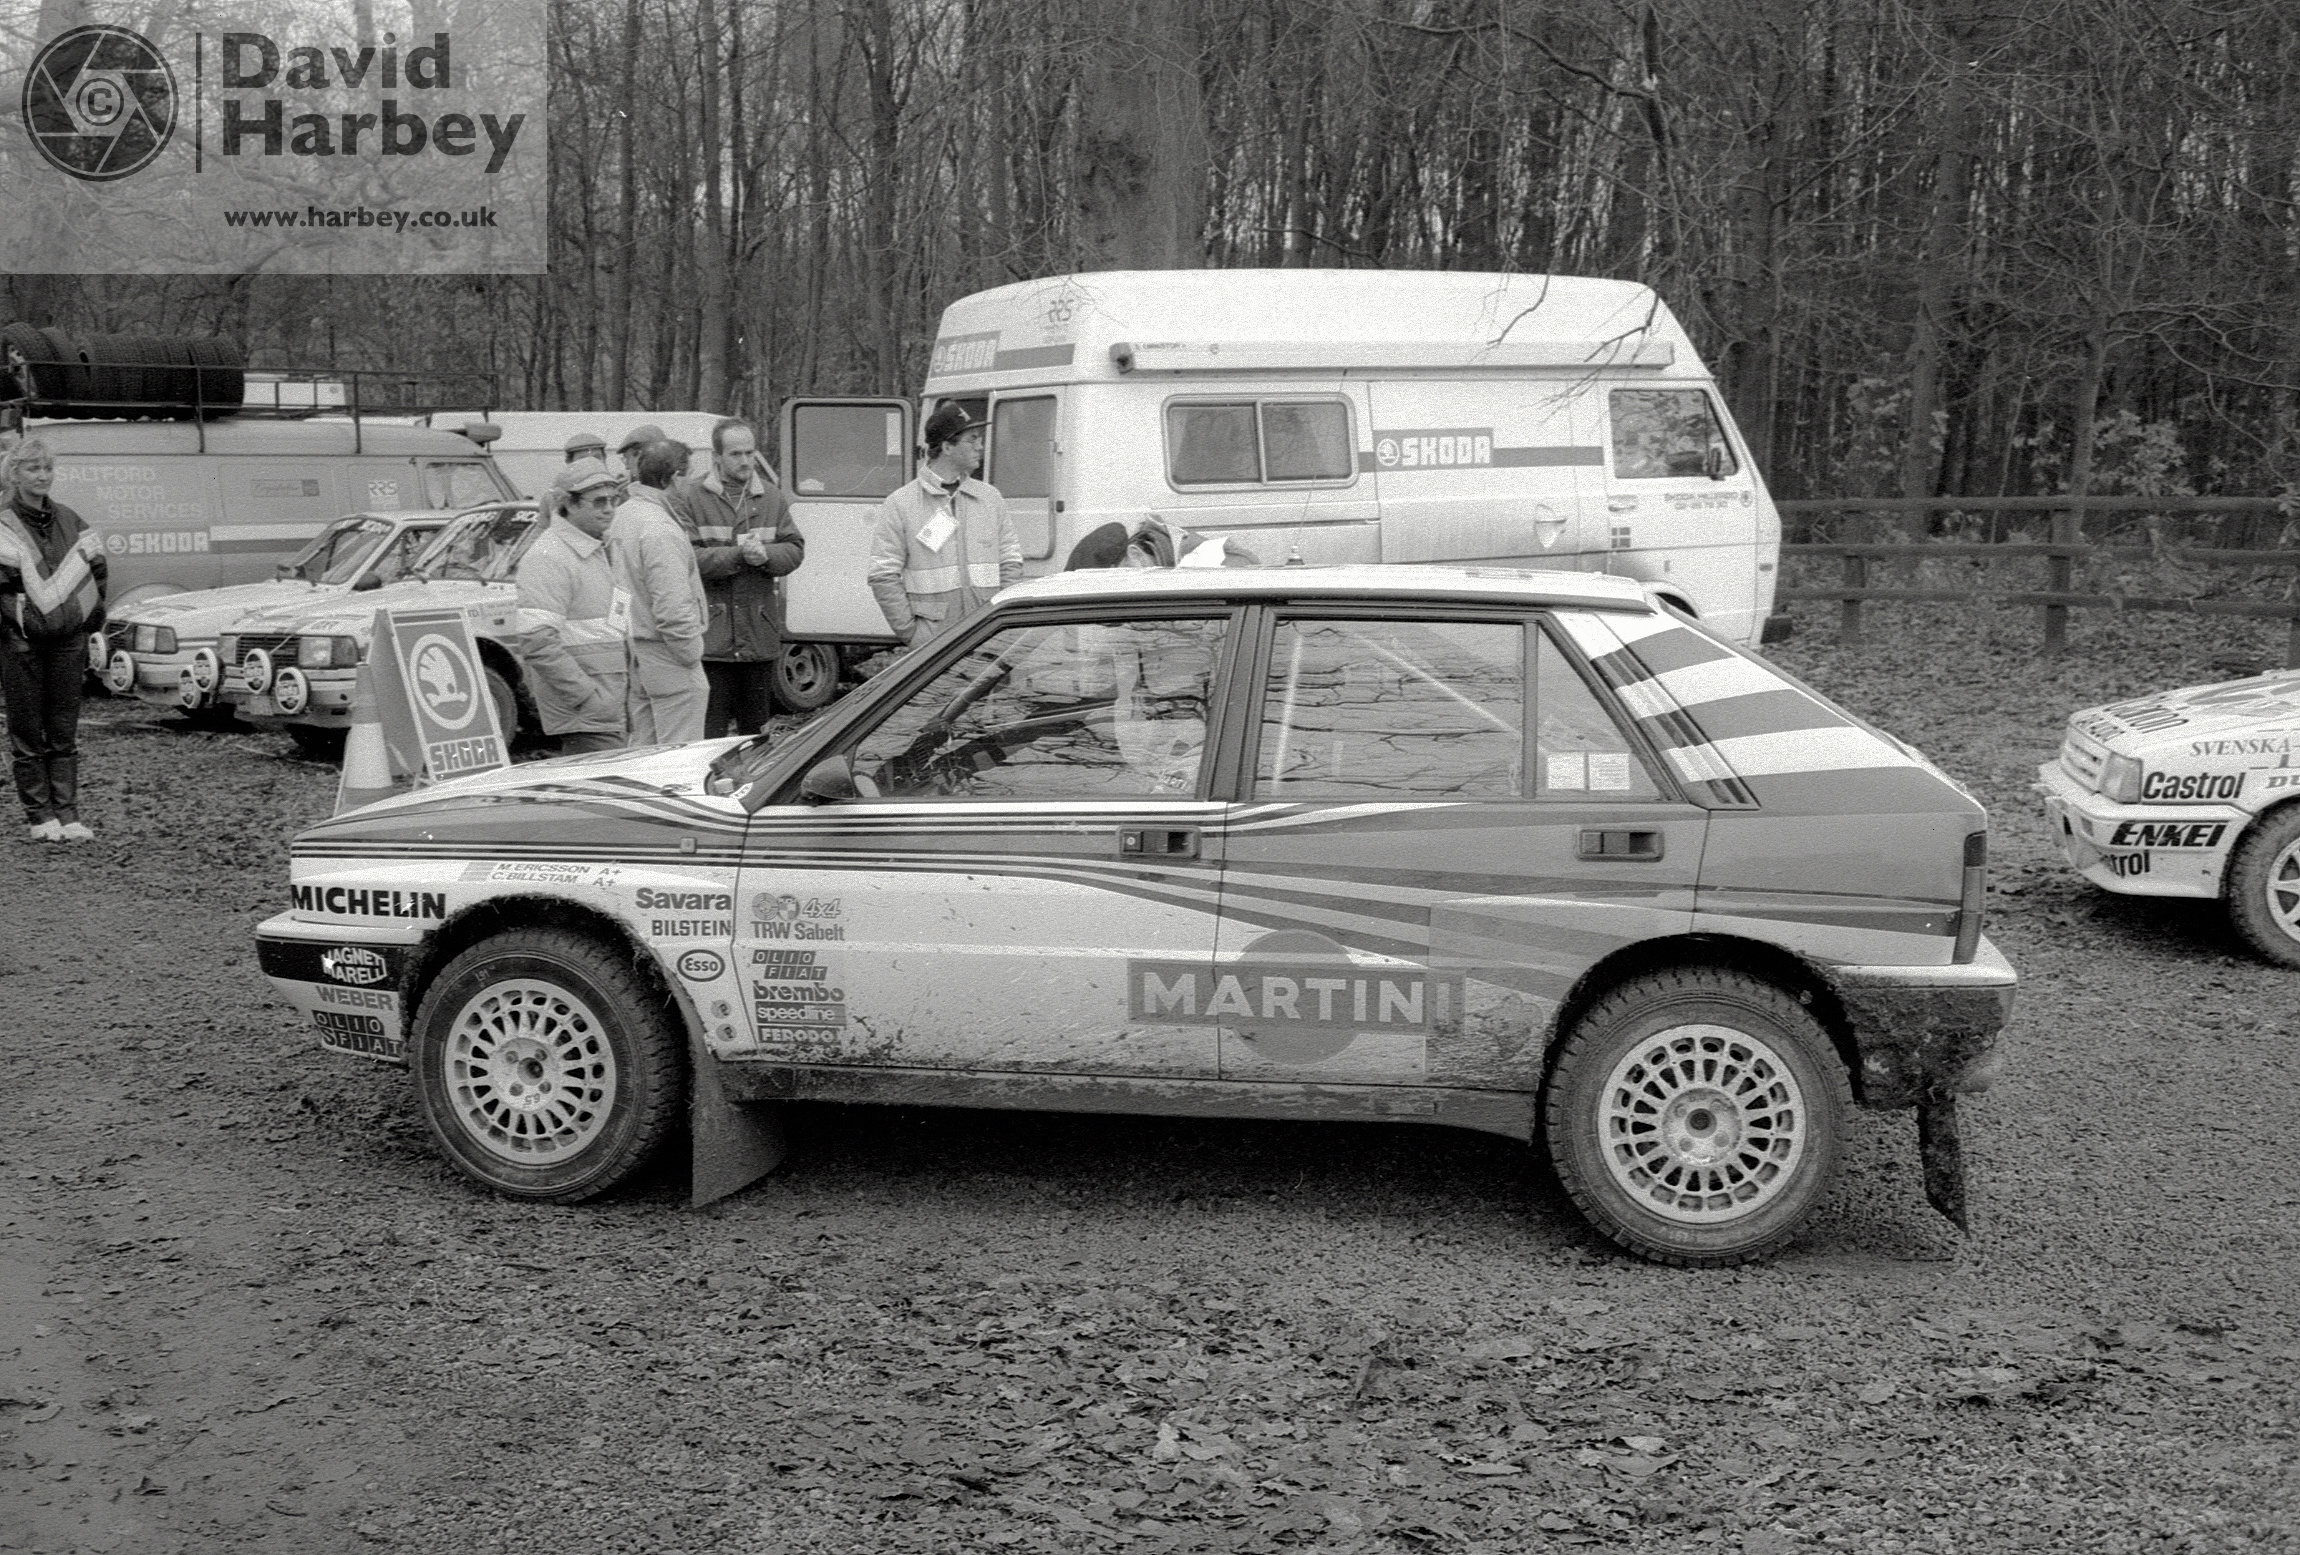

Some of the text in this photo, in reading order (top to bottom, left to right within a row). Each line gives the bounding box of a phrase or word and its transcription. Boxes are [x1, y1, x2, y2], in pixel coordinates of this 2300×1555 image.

[1402, 436, 1490, 465] SKODA
[129, 532, 208, 553] SKODA
[2190, 738, 2290, 756] SVENSKA
[2143, 771, 2247, 799] Castrol
[2109, 823, 2227, 847] ENKEI
[2102, 849, 2151, 878] trol
[291, 884, 446, 919] MICHELIN
[635, 888, 732, 910] Savara
[652, 920, 731, 936] BILSTEIN
[751, 921, 791, 939] TRW
[685, 957, 718, 972] Esso
[756, 951, 812, 963] OLIO
[768, 967, 824, 978] FIAT
[316, 986, 394, 1011] WEBER
[752, 980, 845, 1002] brembo
[1143, 971, 1450, 1026] MARTINI
[317, 1013, 381, 1032] OLIO
[758, 1005, 835, 1021] speedline
[339, 1033, 400, 1054] FIAT
[762, 1029, 834, 1043] FERODO
